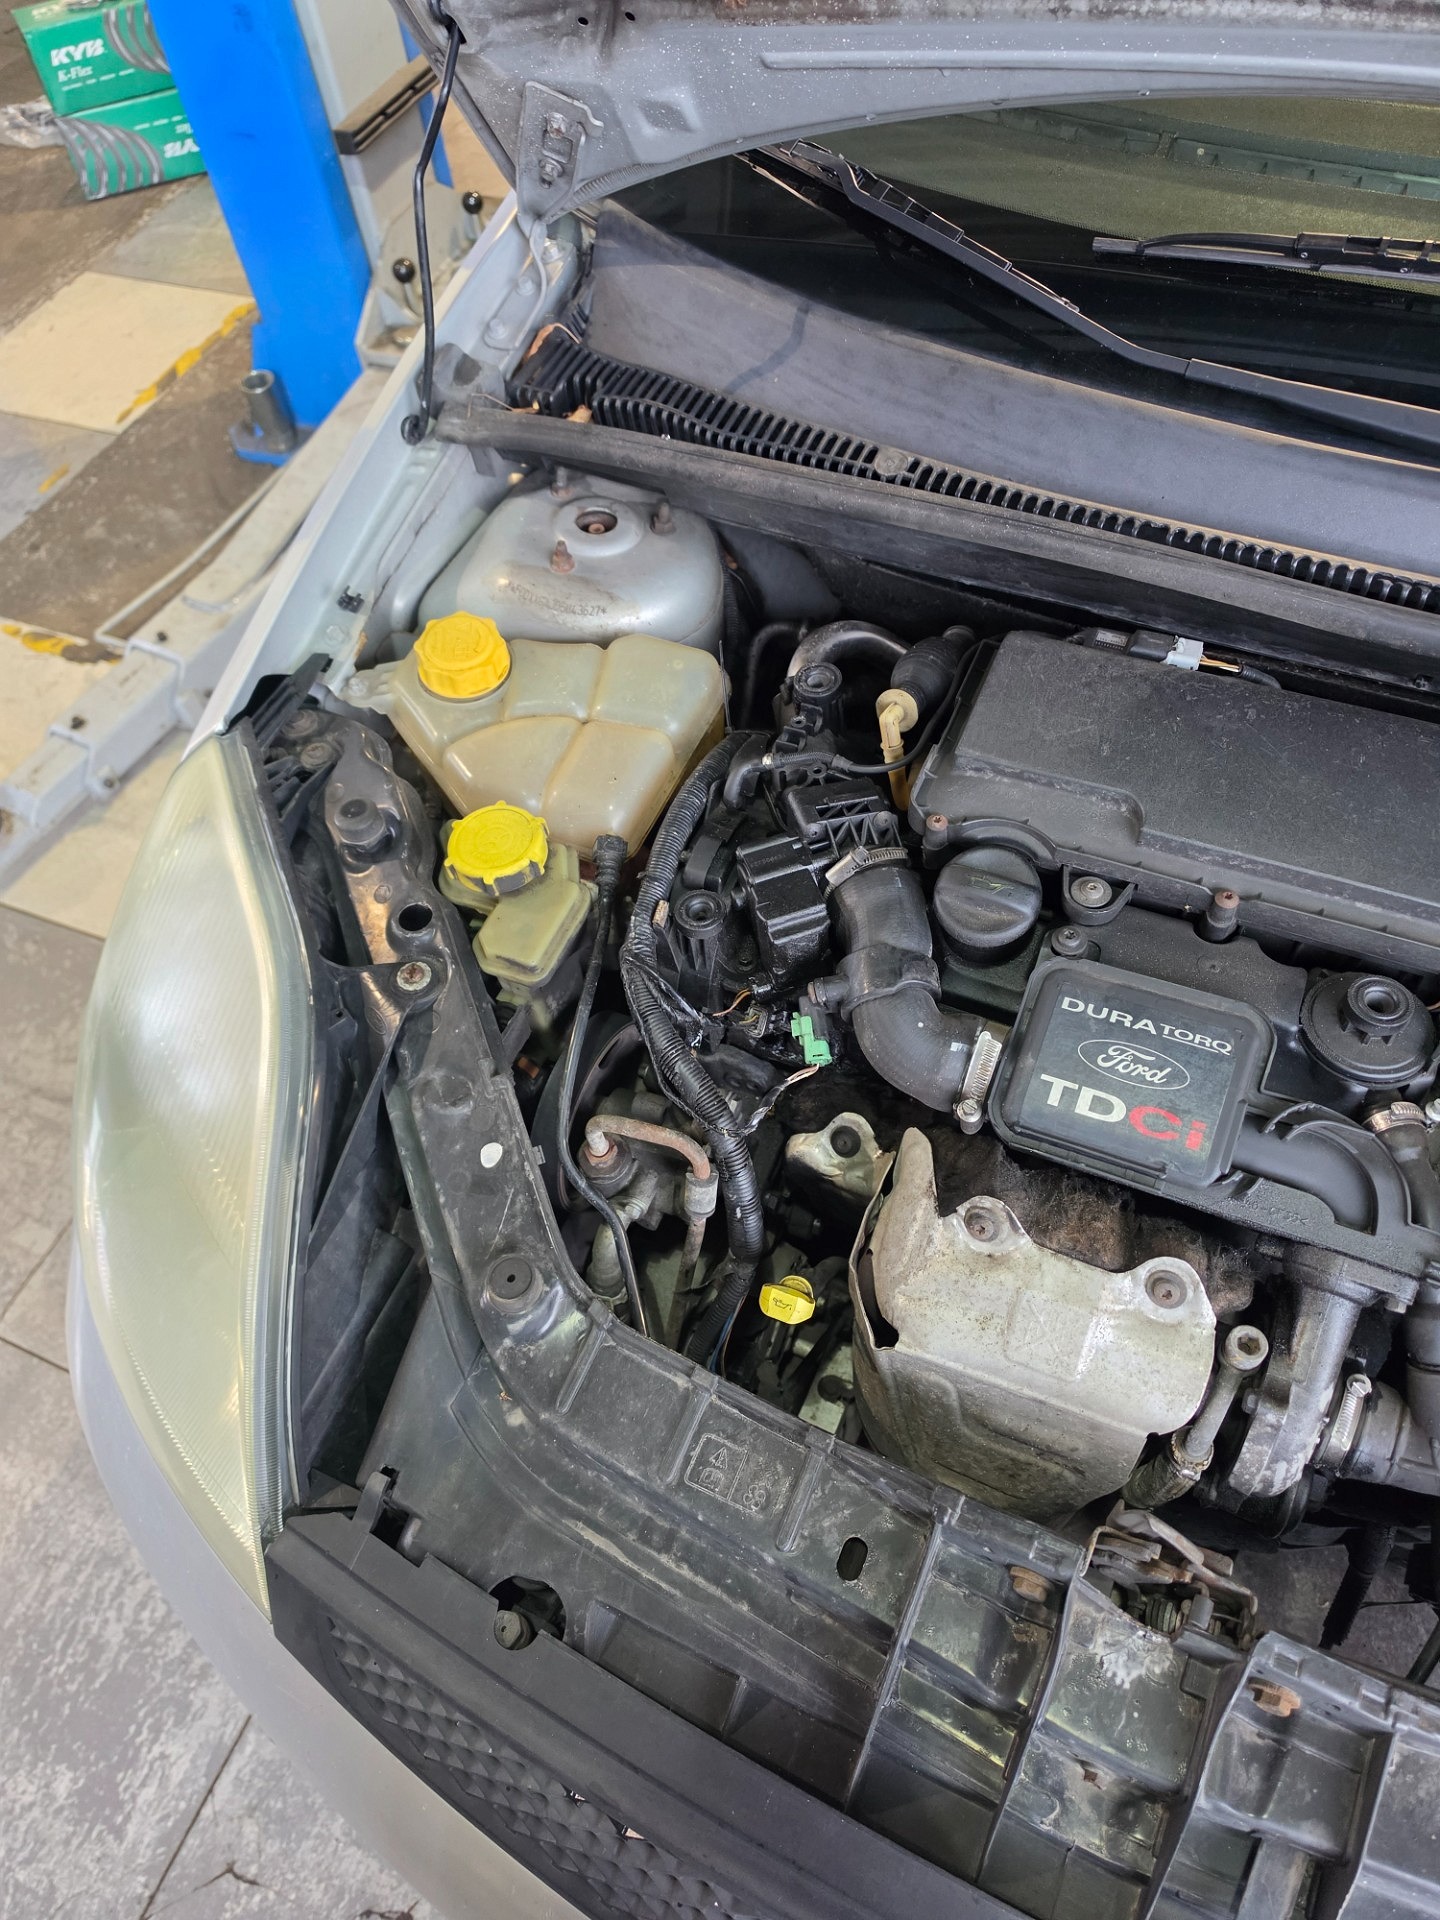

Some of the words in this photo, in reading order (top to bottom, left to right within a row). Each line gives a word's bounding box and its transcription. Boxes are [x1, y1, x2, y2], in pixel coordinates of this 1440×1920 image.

[51, 38, 105, 66] KYB
[1061, 997, 1234, 1056] DURATORQ
[1096, 1045, 1168, 1085] Ford
[1040, 1073, 1207, 1151] TDCi
